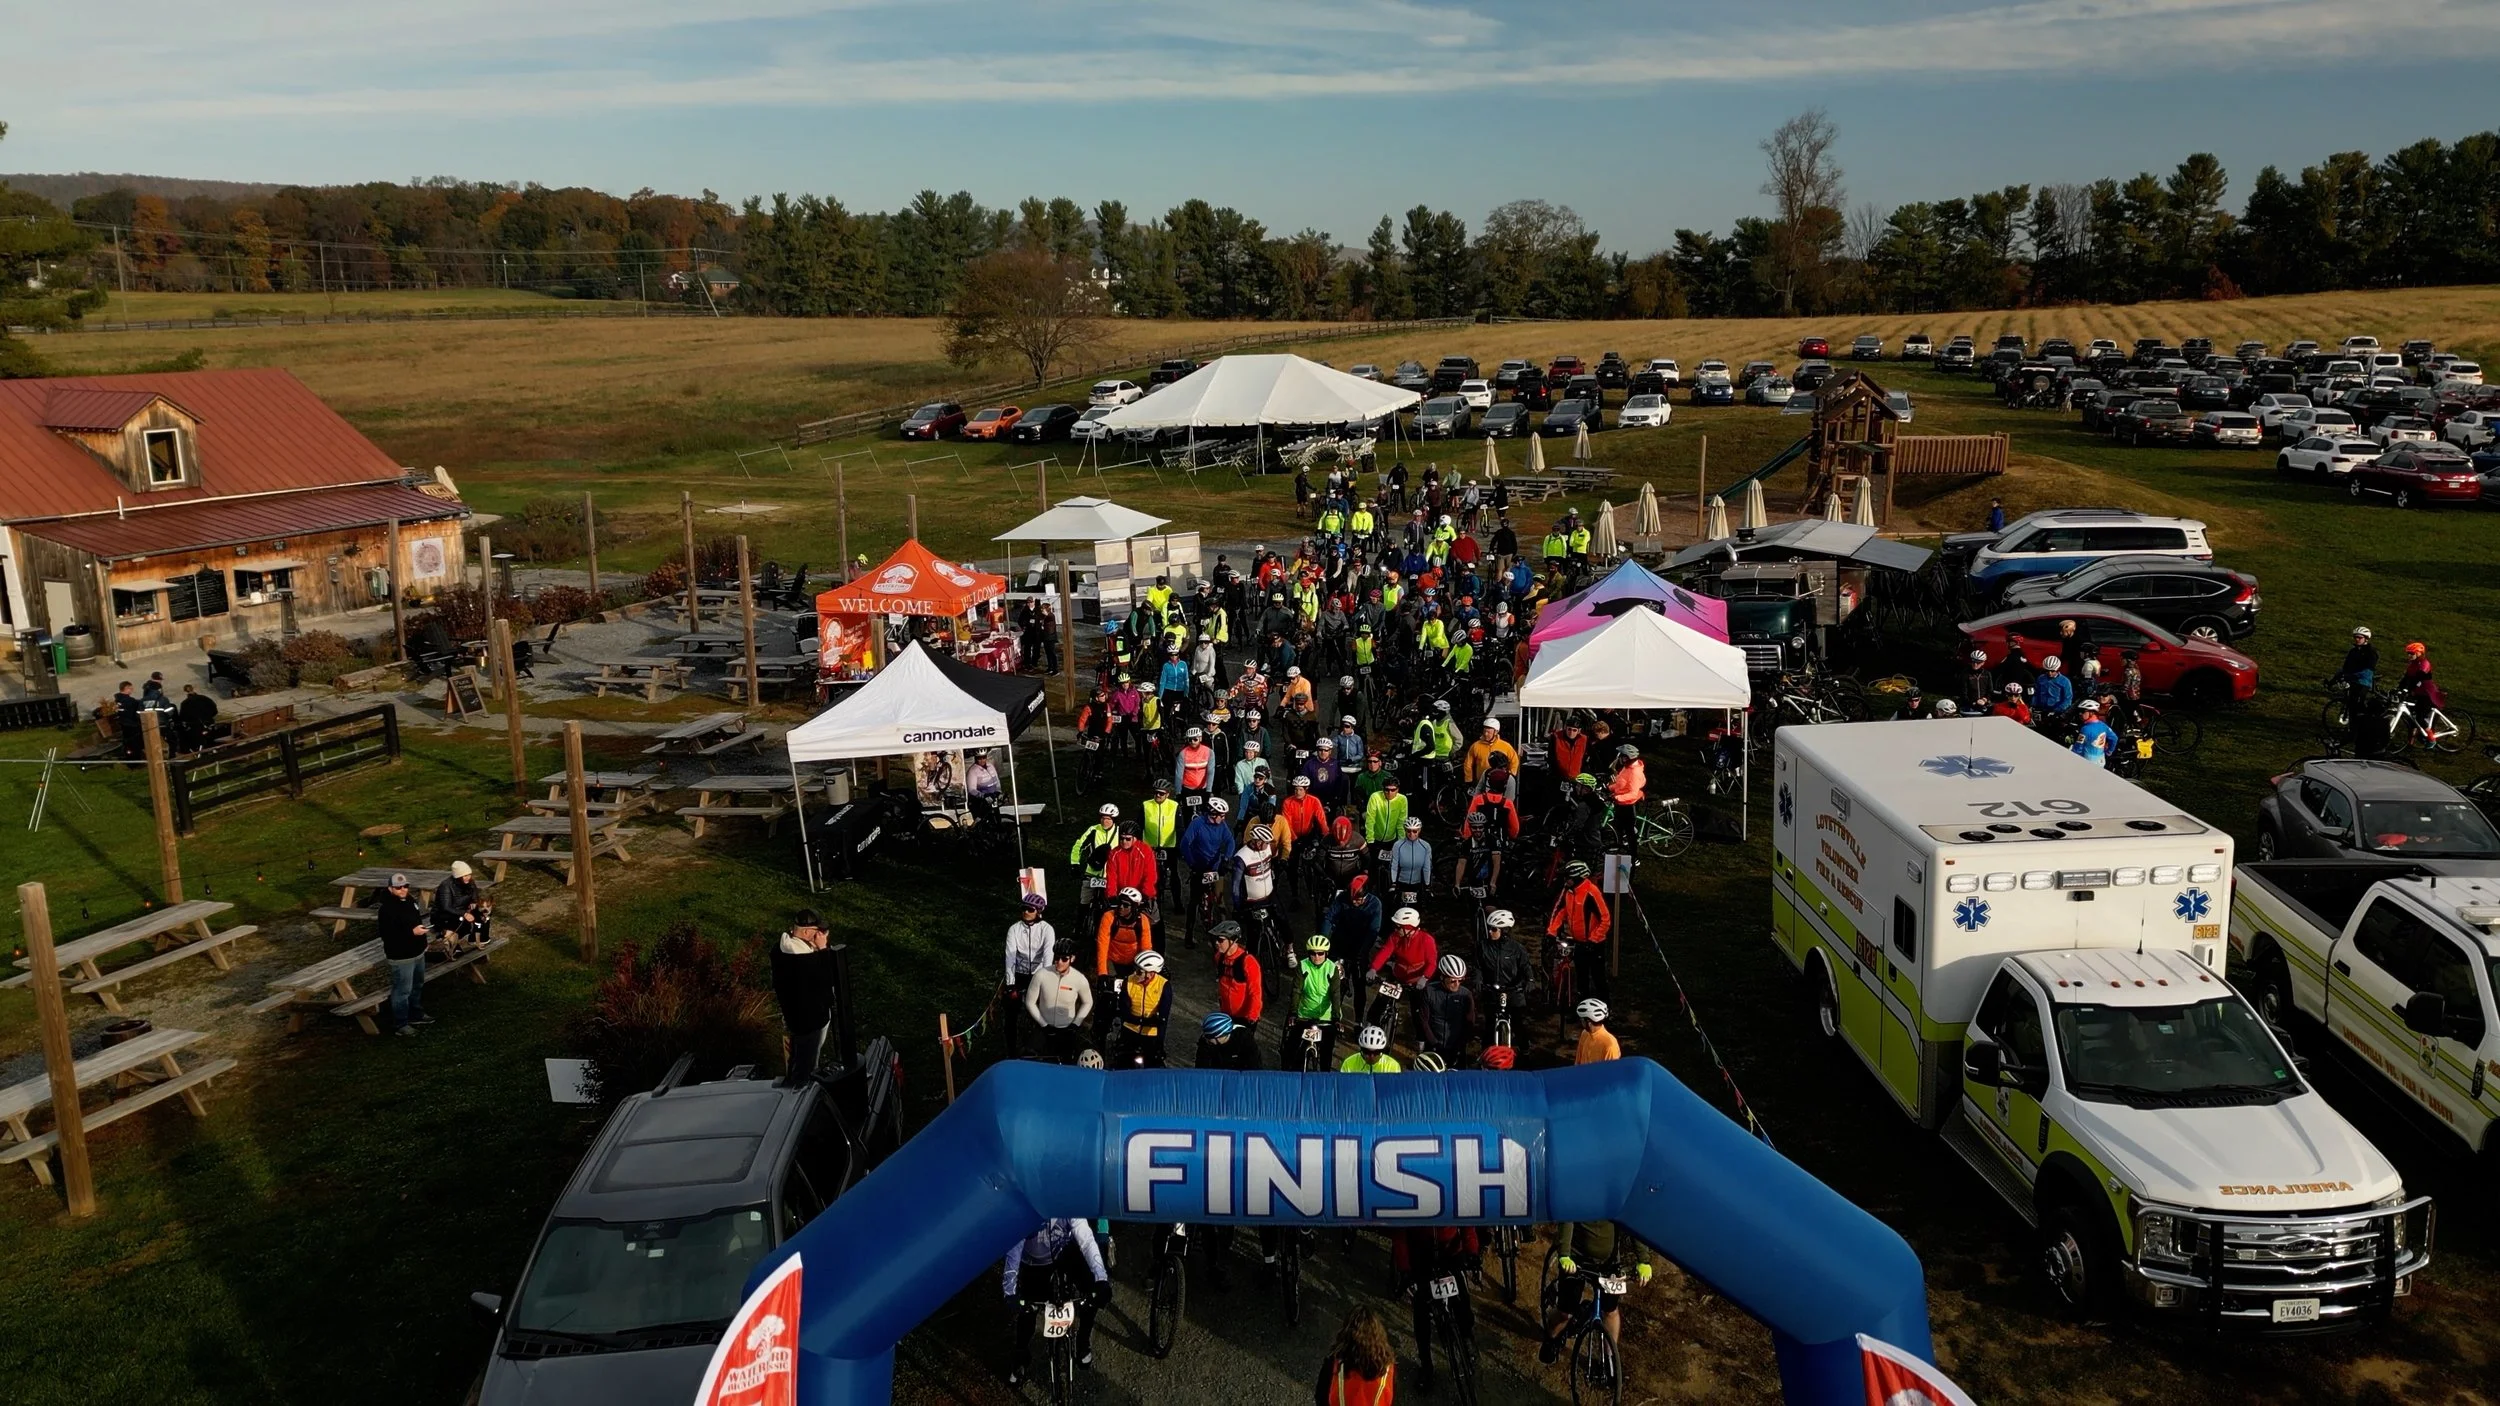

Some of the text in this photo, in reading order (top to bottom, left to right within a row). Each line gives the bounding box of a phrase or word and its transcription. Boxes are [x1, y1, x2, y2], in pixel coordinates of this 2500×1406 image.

[961, 582, 999, 609] WELCOME
[838, 598, 934, 615] WELCOME
[903, 725, 996, 744] cannondale
[1967, 799, 2091, 818] 612
[1816, 813, 1867, 870] LOVETTSVILLE
[1821, 838, 1859, 885] VOLUNTEER
[1816, 857, 1864, 915] FIRE & RESCUE
[2194, 925, 2220, 938] 612B
[1125, 1129, 1531, 1219] FINISH
[1435, 1281, 1457, 1296] 412
[1048, 1308, 1070, 1320] 401
[2280, 1306, 2312, 1317] EV4036
